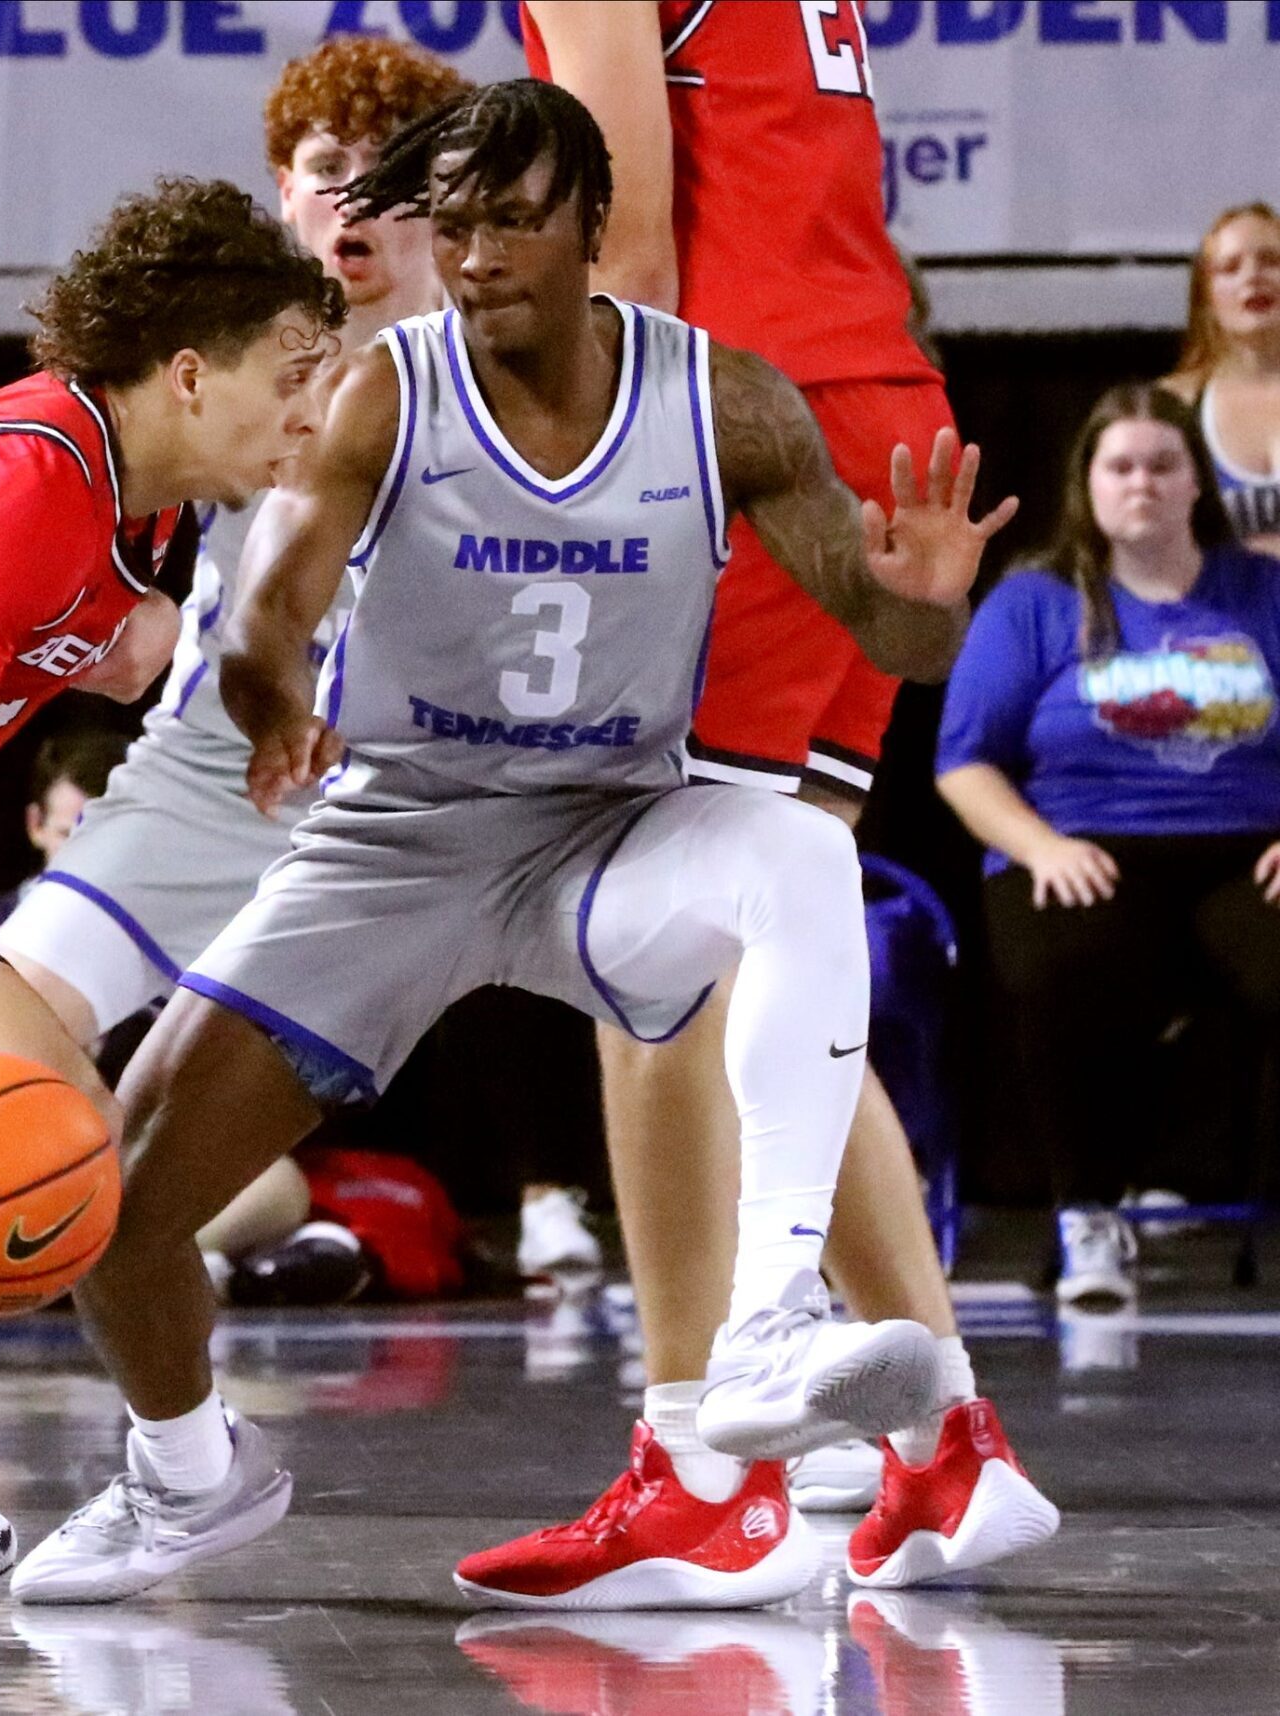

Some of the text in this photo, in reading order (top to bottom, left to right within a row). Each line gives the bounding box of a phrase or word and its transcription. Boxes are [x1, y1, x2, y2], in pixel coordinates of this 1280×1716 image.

[884, 133, 988, 226] er
[453, 534, 650, 574] MIDDLE
[498, 581, 592, 718] 3
